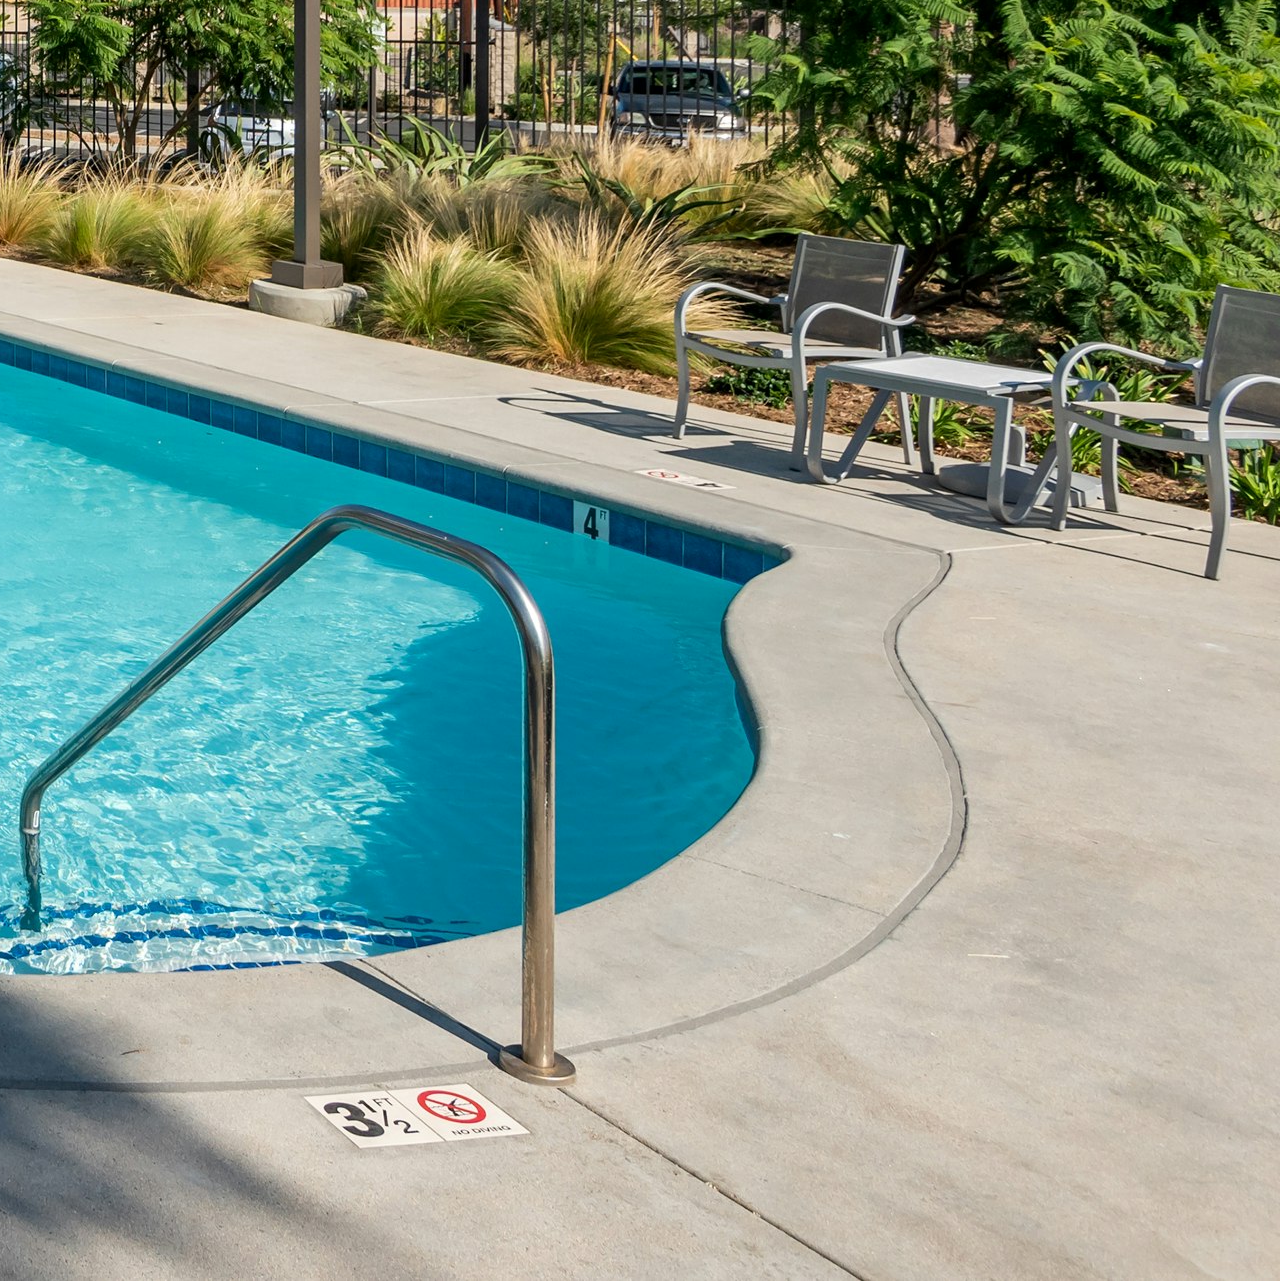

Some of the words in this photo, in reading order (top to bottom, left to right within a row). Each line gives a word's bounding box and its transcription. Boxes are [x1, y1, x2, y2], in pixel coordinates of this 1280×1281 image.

[584, 507, 599, 540] 4
[600, 510, 607, 520] FT
[323, 1102, 385, 1138] 3
[372, 1097, 393, 1107] FT
[471, 1125, 512, 1134] DIVING
